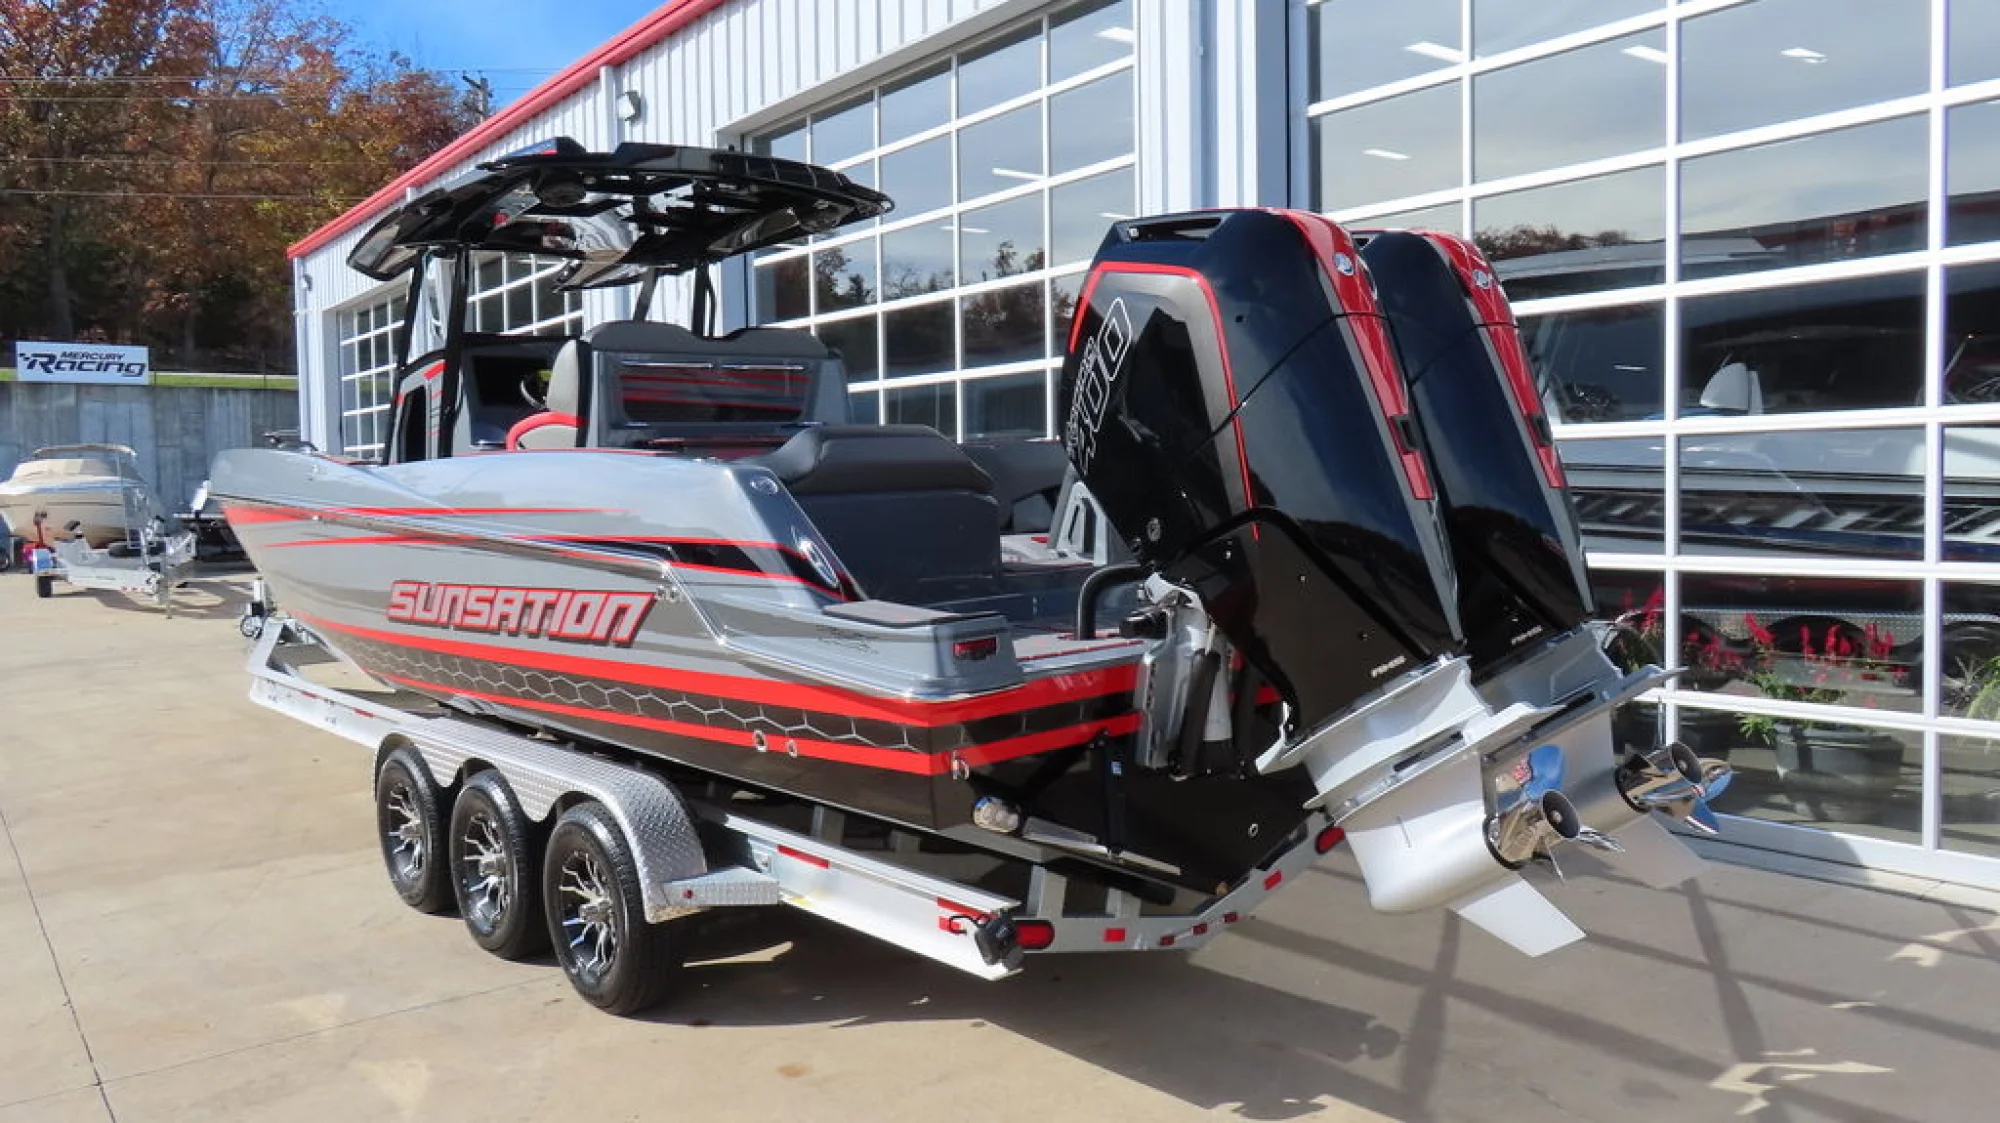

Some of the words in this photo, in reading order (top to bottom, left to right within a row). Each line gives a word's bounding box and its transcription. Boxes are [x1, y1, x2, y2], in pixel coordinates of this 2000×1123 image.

[26, 353, 146, 377] Racing
[60, 351, 125, 360] MERCURY
[387, 580, 657, 648] SUNSATION
